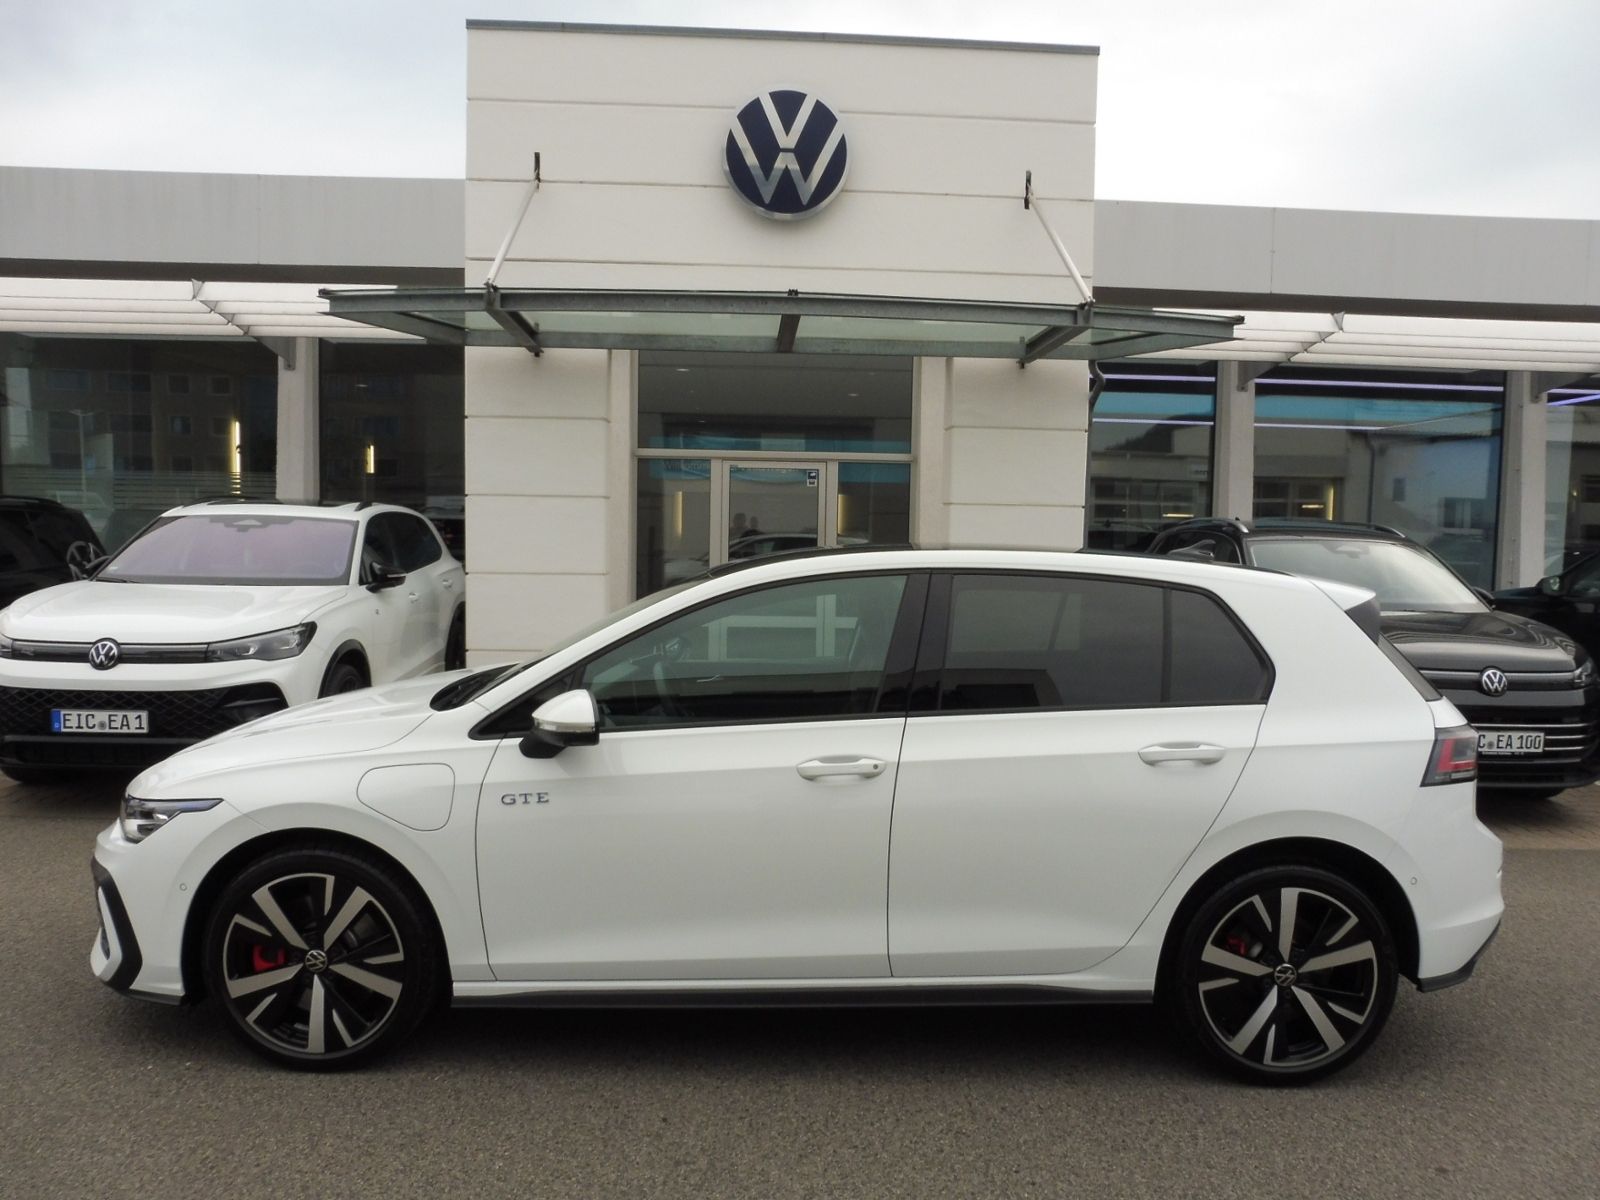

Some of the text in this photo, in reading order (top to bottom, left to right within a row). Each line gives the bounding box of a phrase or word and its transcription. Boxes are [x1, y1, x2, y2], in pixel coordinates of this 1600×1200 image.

[726, 87, 847, 213] VW
[62, 713, 145, 730] EIC EA 1
[1496, 734, 1513, 749] EA
[1516, 734, 1542, 750] 100
[501, 791, 550, 806] GTE
